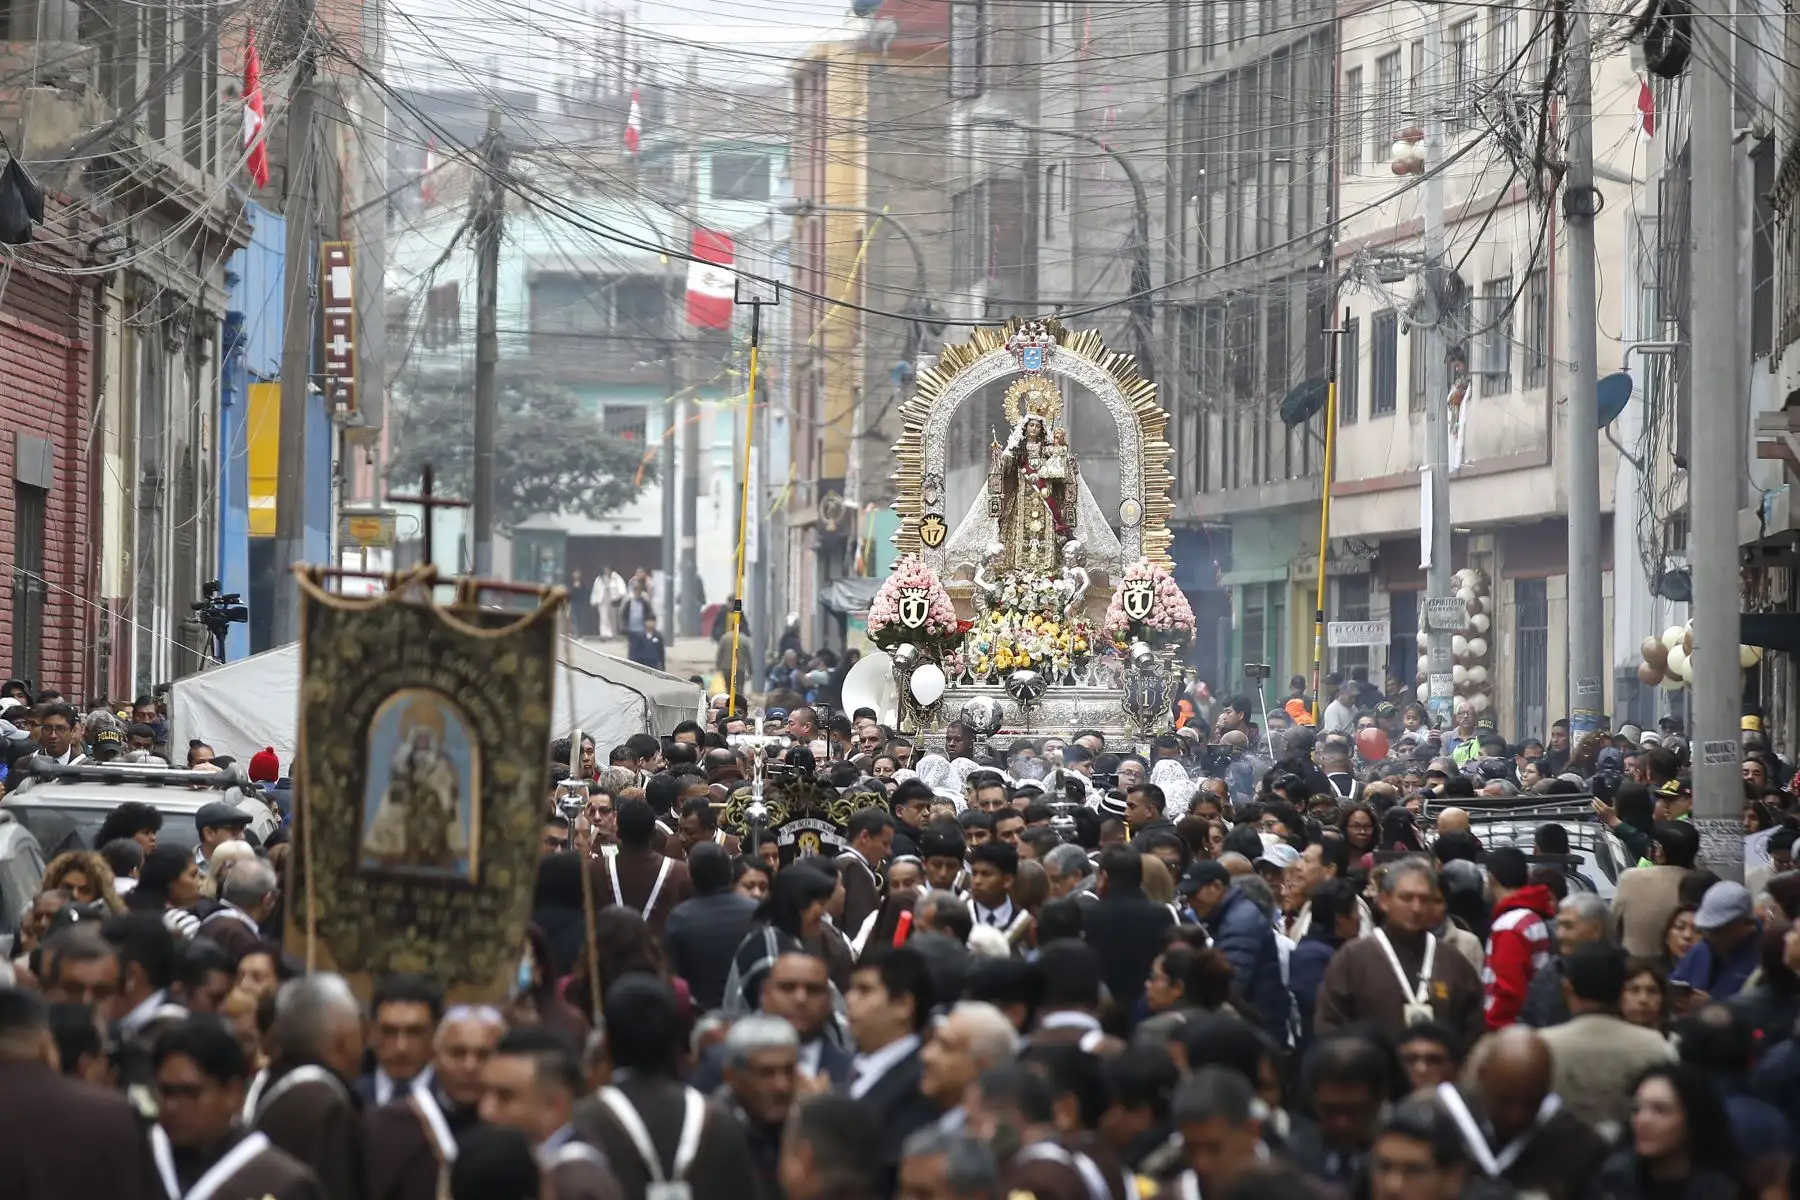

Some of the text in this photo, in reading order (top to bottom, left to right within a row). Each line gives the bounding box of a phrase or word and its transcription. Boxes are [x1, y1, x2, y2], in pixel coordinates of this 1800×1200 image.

[926, 529, 940, 542] 17
[1131, 592, 1143, 613] 1
[905, 600, 919, 621] 1
[1345, 623, 1384, 633] COLOR
[1142, 689, 1149, 706] 1
[98, 731, 120, 742] POLICIA
